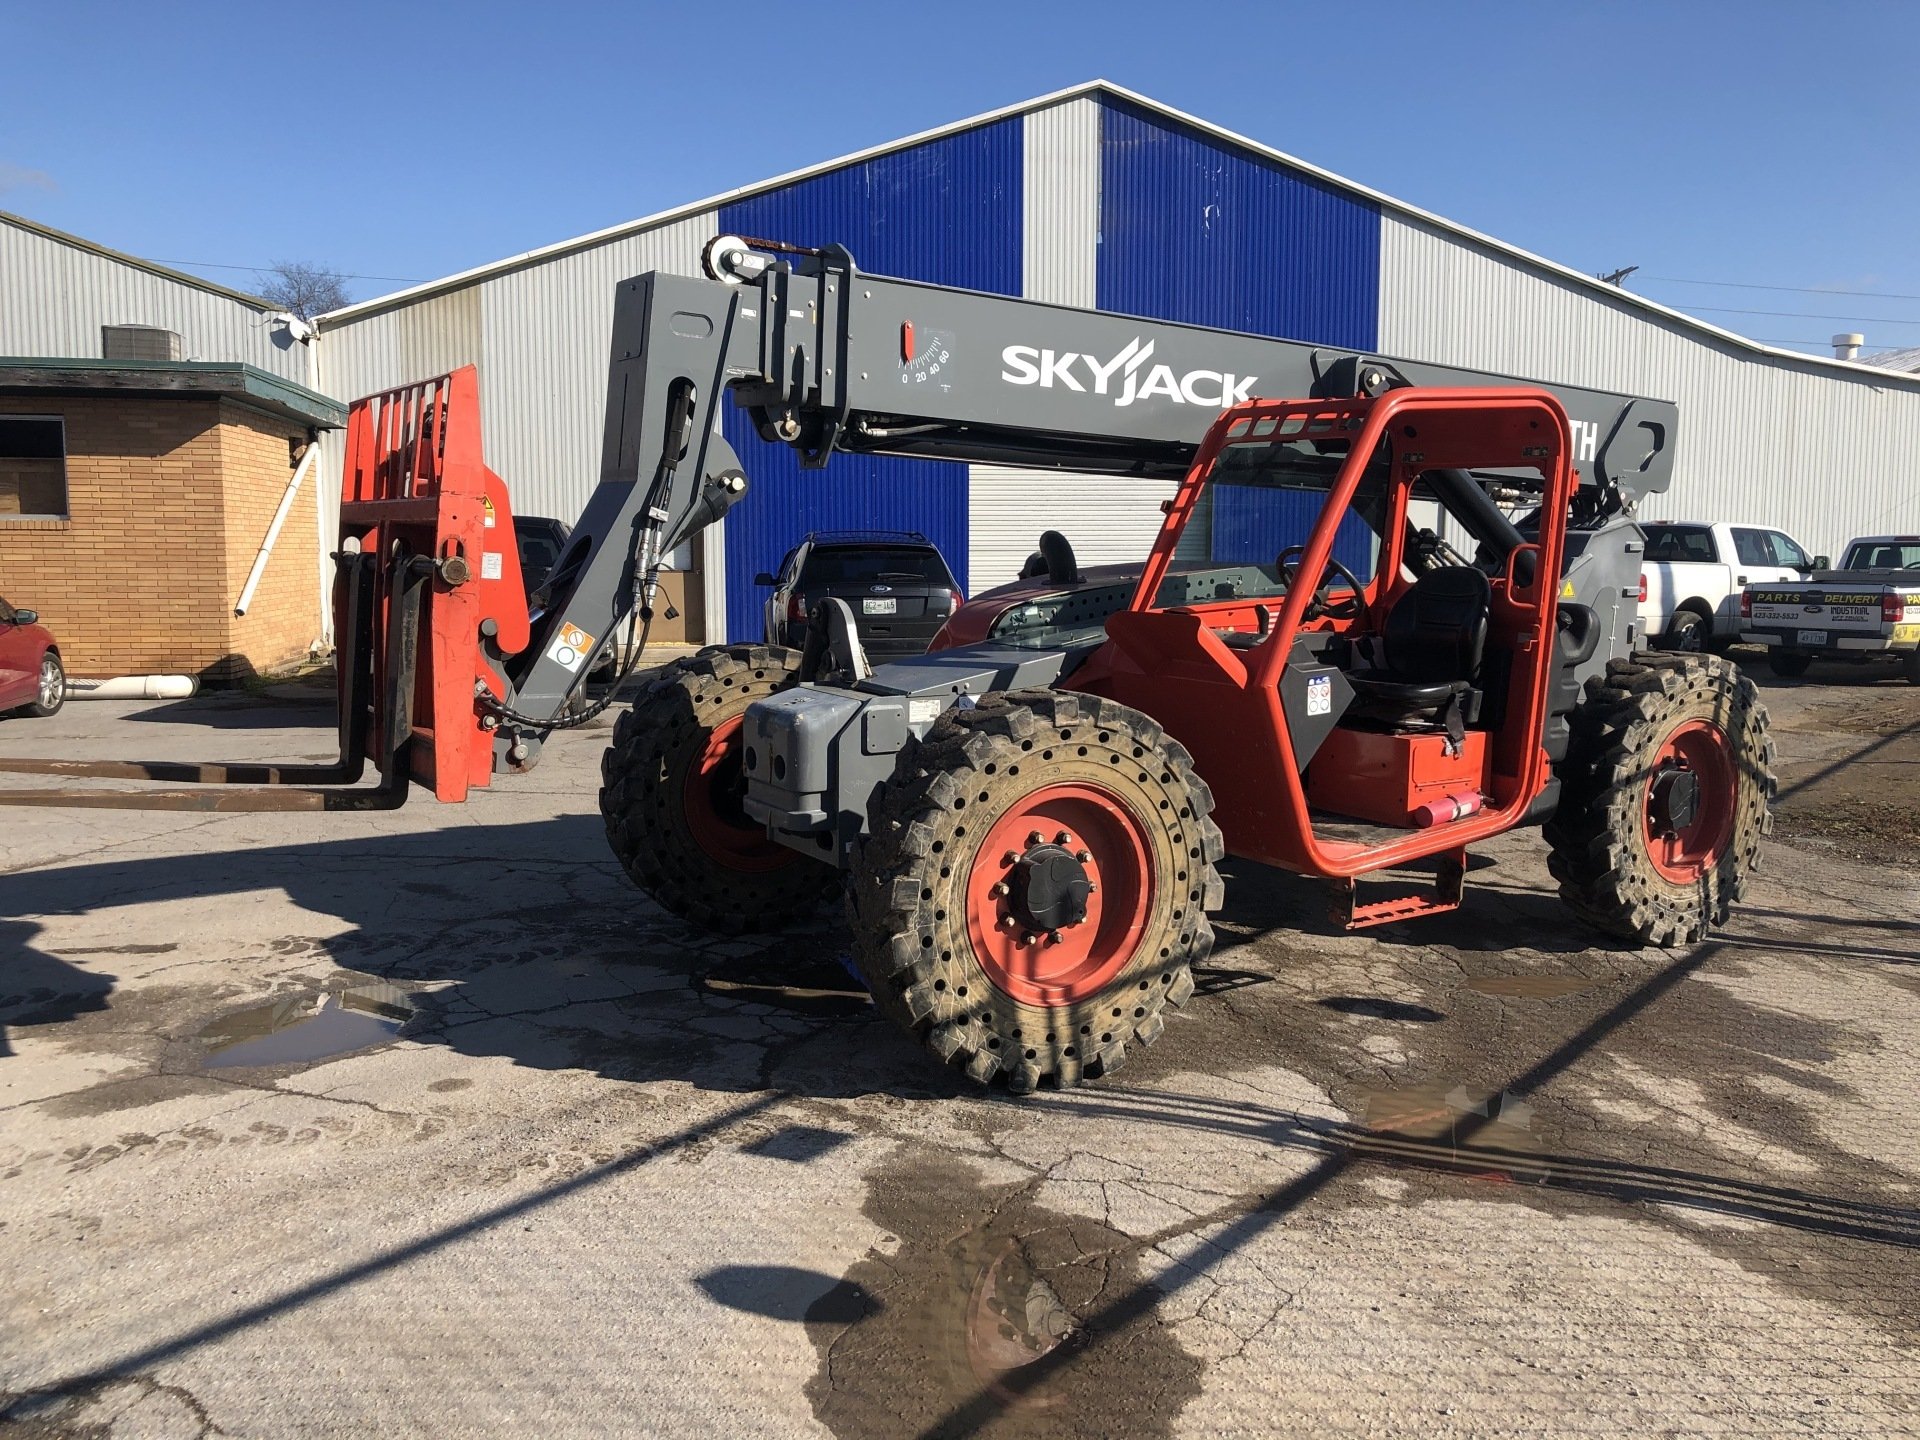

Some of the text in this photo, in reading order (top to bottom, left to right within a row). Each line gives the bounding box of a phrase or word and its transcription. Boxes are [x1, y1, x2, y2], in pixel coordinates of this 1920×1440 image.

[902, 350, 950, 384] 0 20 40 60
[1001, 336, 1258, 408] SKYJACK
[1757, 593, 1877, 604] PARTS DELIVERY
[1830, 606, 1870, 616] INDUSTRIAL
